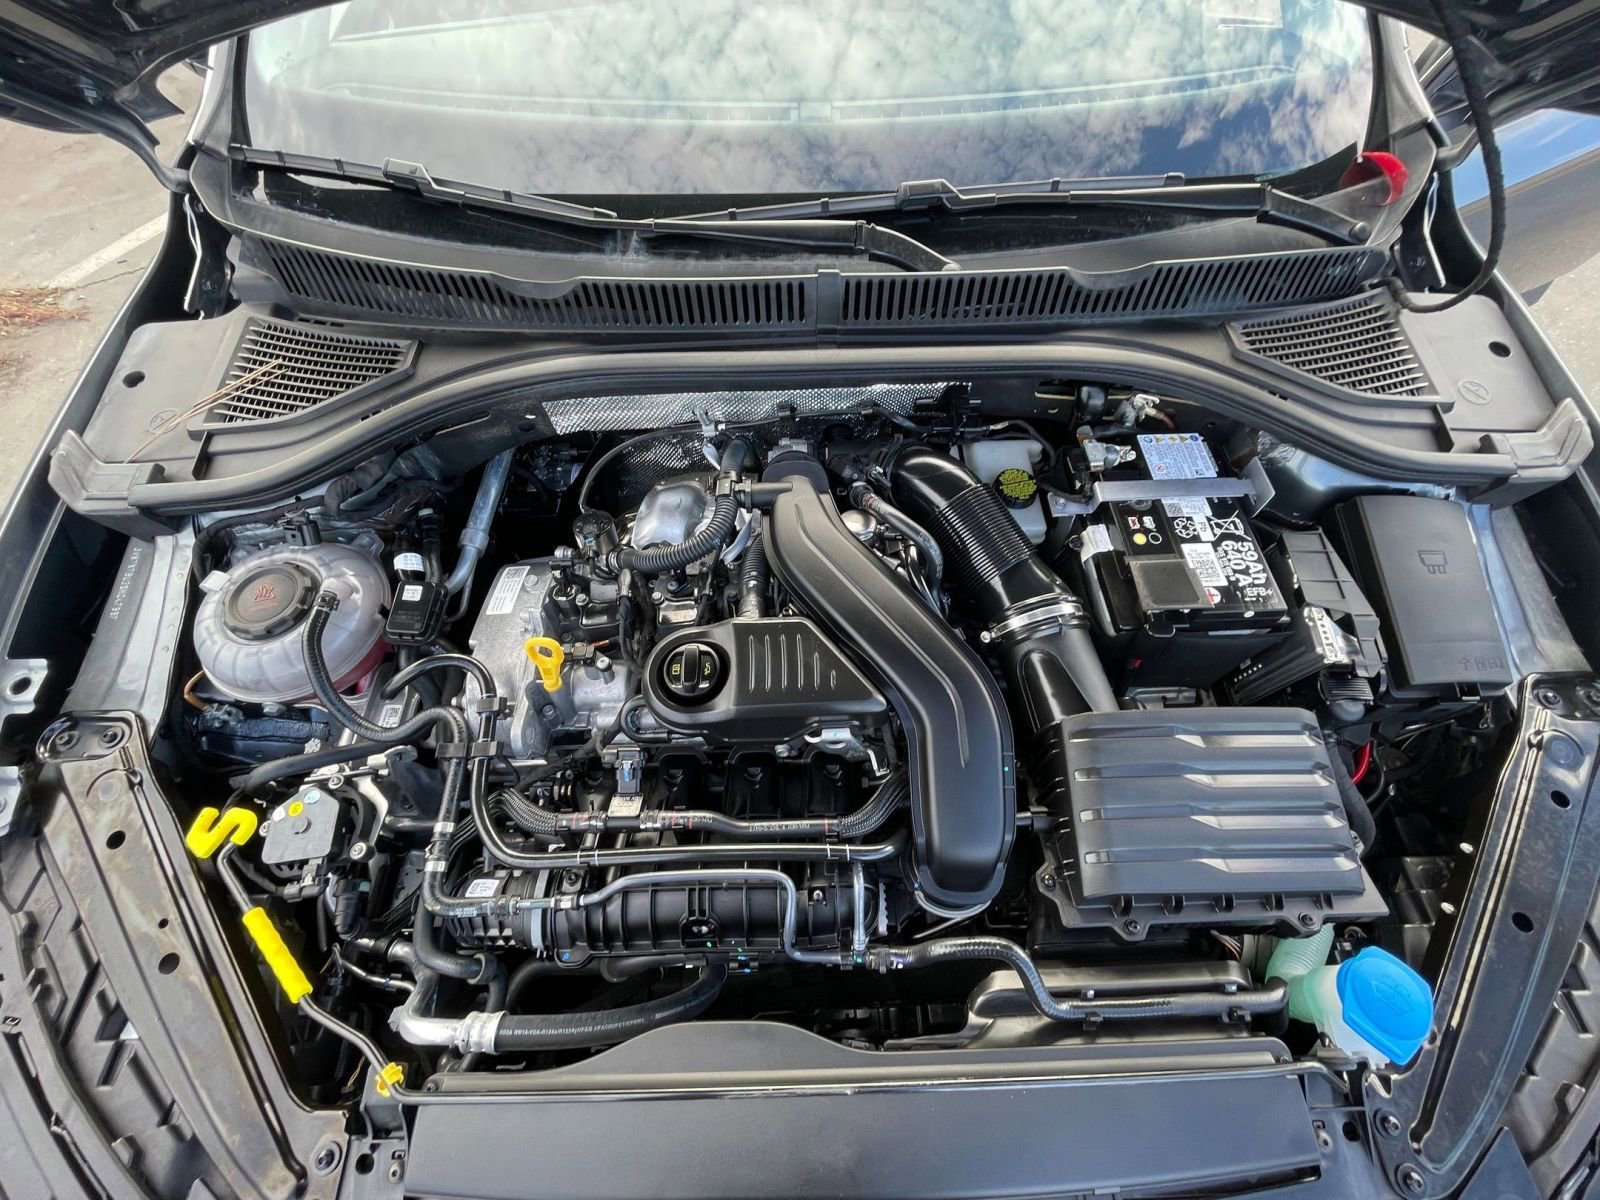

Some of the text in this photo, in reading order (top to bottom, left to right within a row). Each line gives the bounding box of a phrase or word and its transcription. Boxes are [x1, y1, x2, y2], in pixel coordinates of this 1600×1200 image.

[1222, 540, 1246, 570] 640
[1235, 573, 1254, 587] A
[1238, 541, 1267, 584] 59Ah
